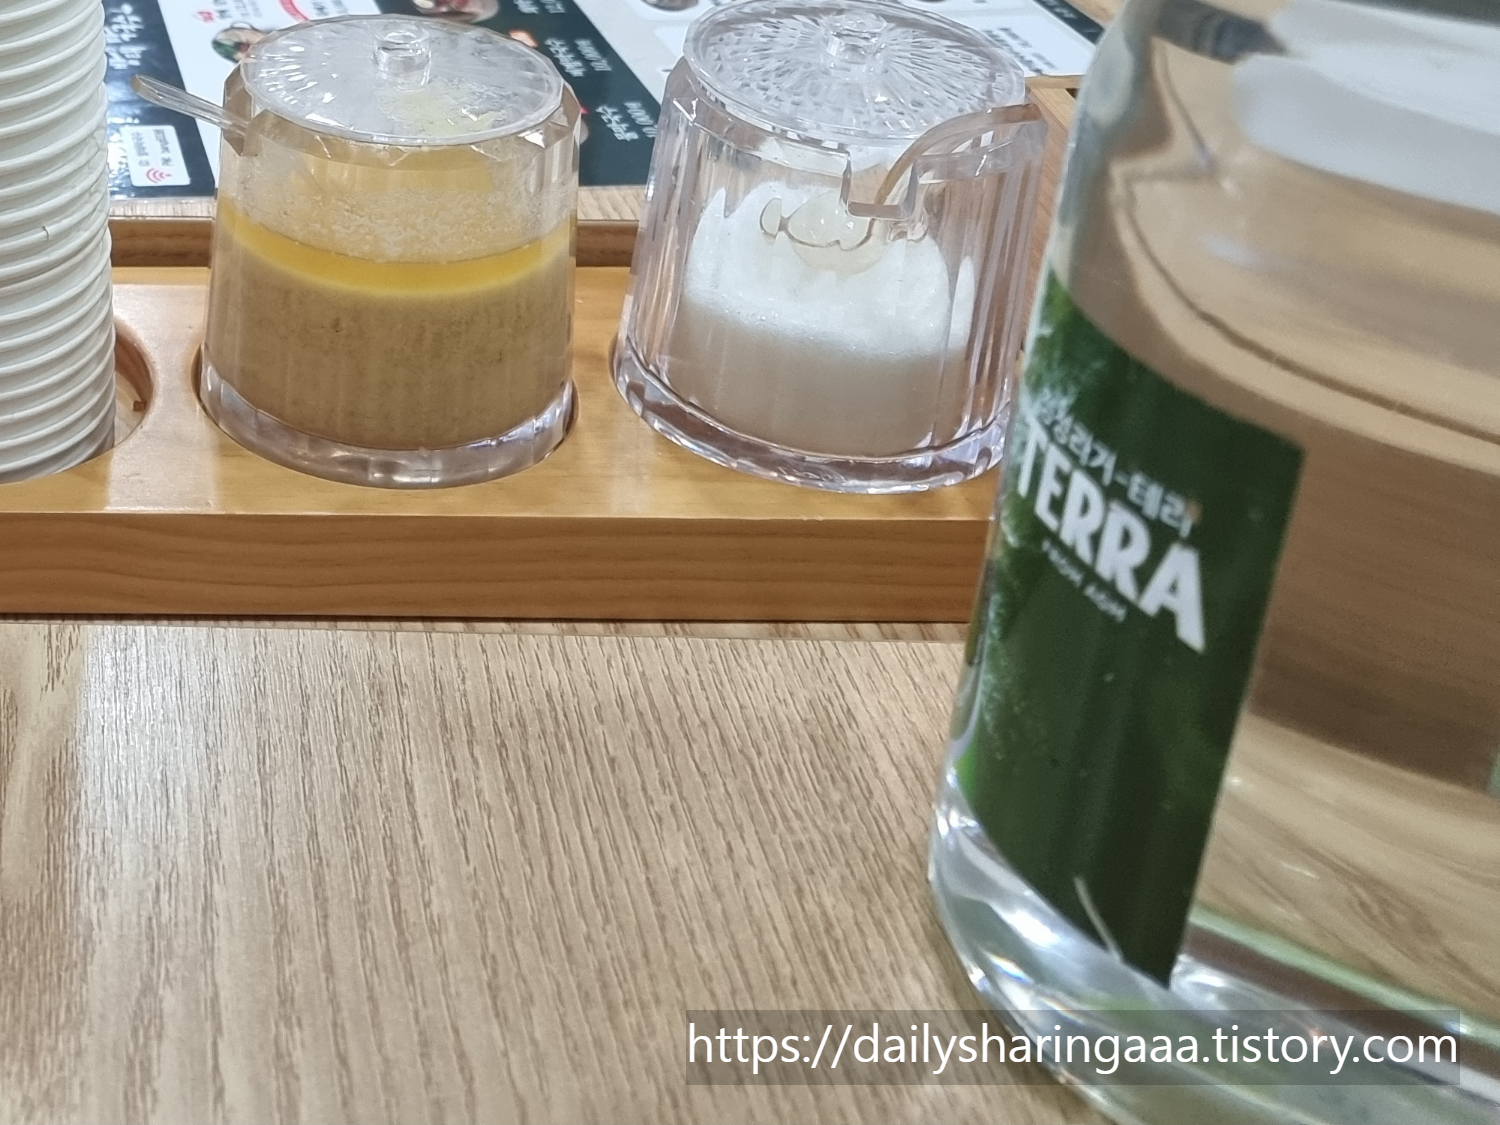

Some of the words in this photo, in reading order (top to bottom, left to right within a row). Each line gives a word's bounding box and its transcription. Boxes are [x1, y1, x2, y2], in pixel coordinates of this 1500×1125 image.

[545, 38, 585, 77] 비빔막국수
[596, 105, 638, 141] 물막국수
[1017, 399, 1206, 654] TERRA
